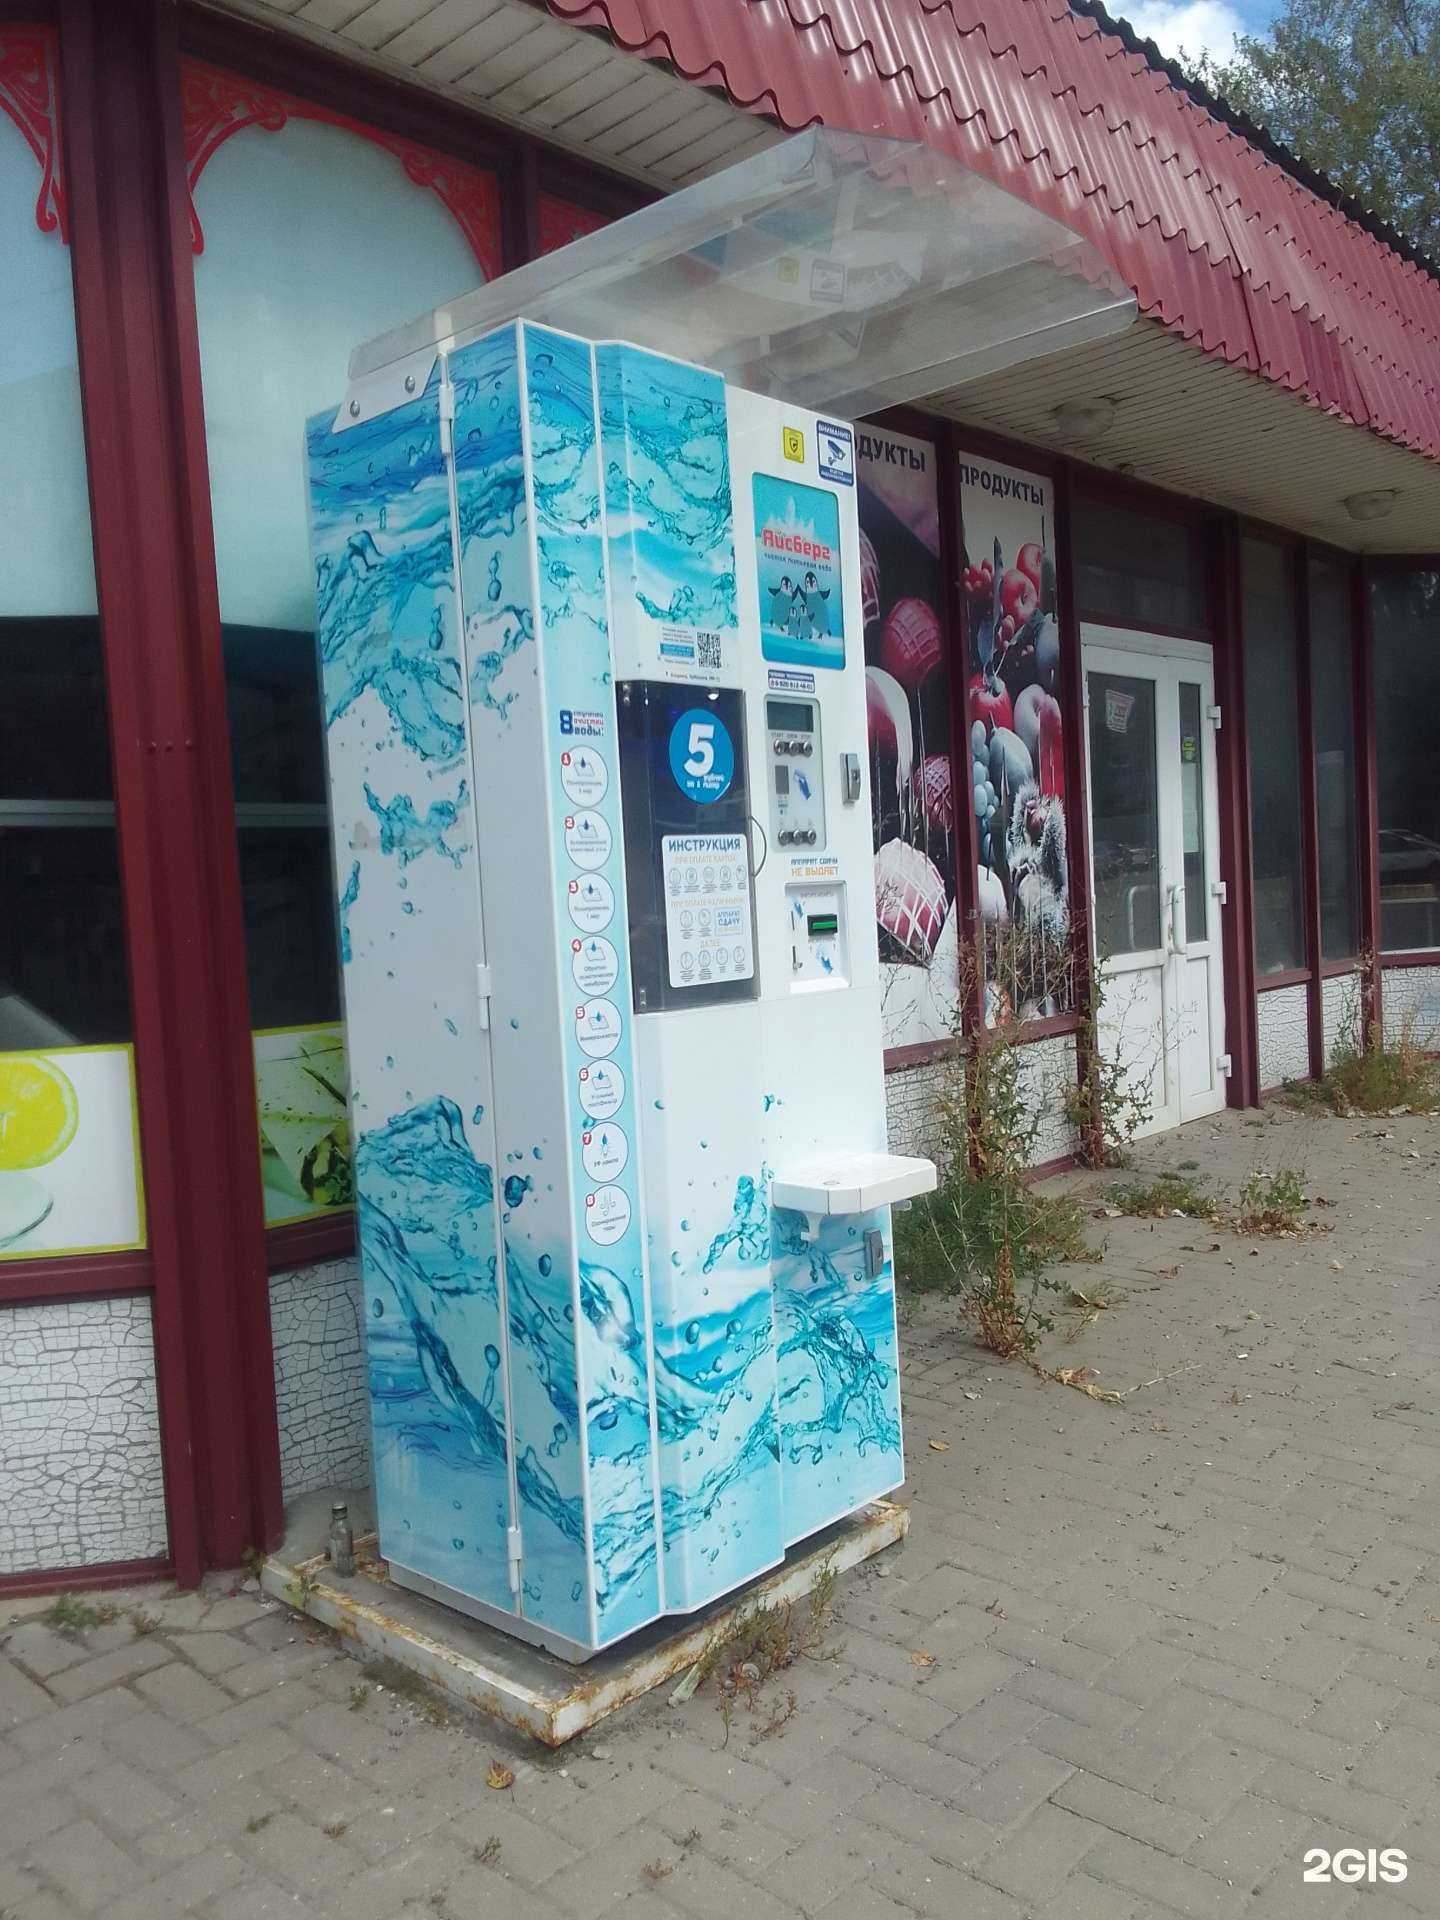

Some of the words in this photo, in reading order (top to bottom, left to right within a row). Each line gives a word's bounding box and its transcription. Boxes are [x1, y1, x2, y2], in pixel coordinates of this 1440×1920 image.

[855, 434, 926, 472] ДУКТЫ
[960, 463, 1045, 507] ПРОДУКТЫ
[762, 528, 831, 561] Айсберг
[560, 710, 573, 734] 8
[684, 723, 714, 778] 5
[668, 838, 741, 853] ИНСТРУКЦИЯ
